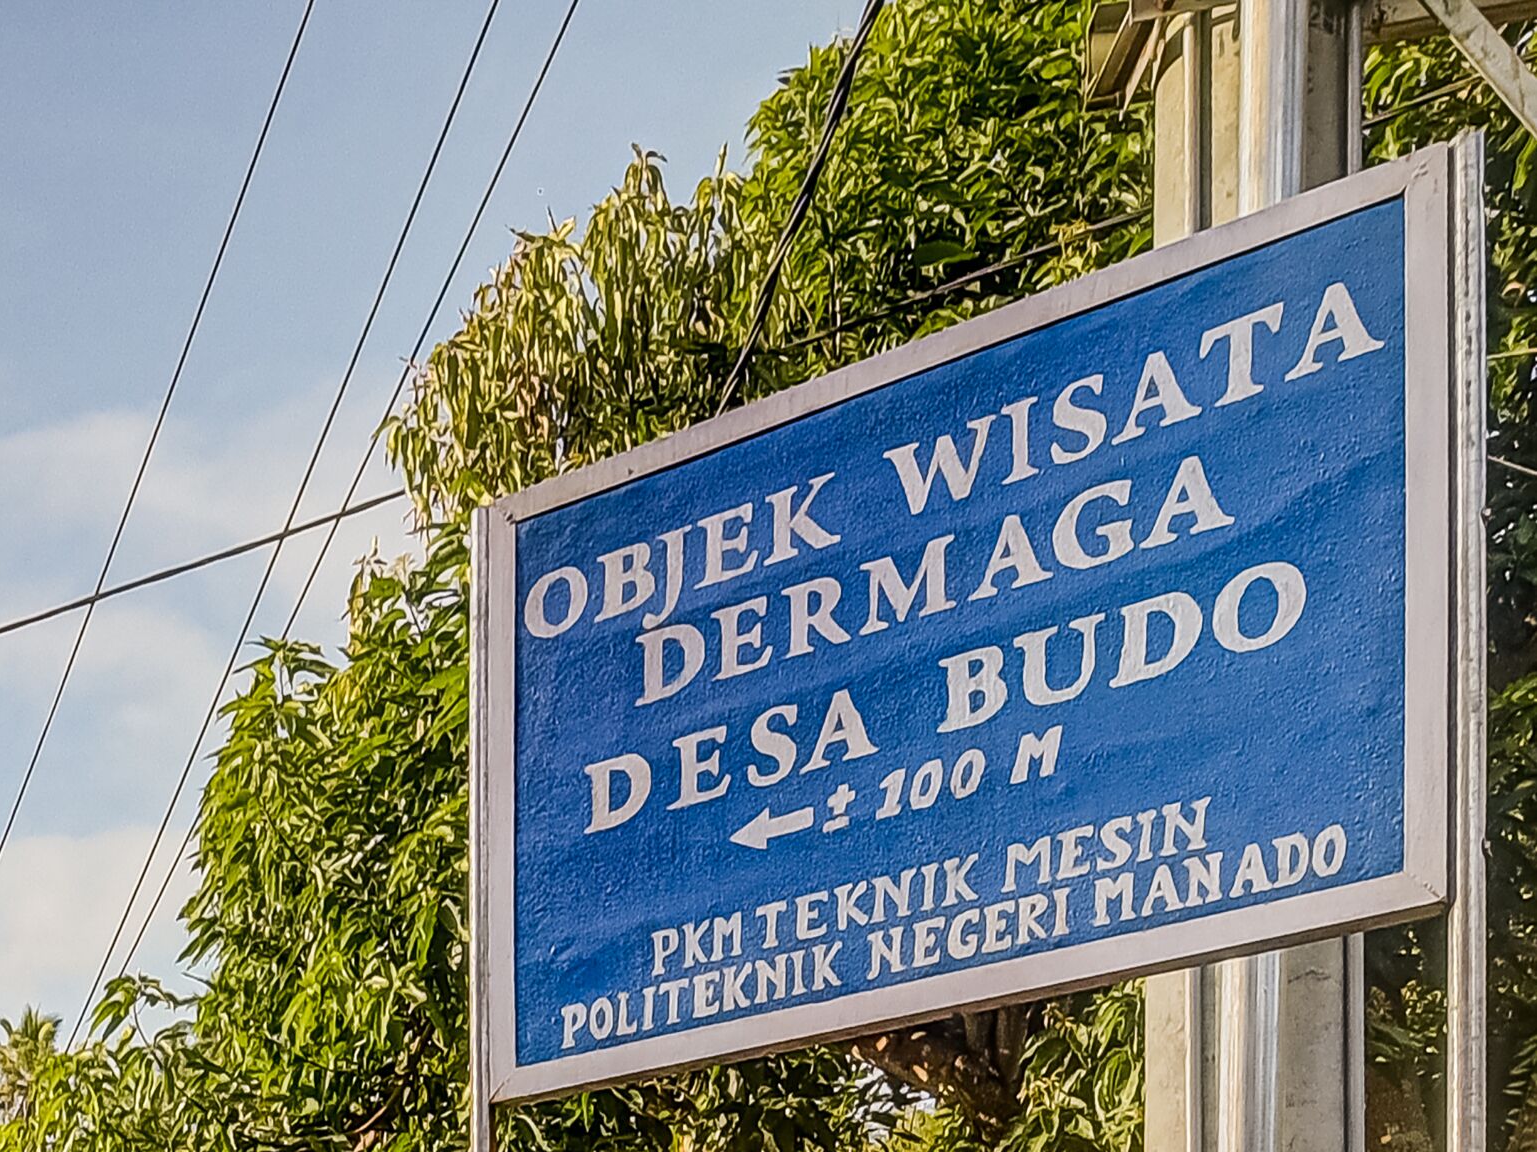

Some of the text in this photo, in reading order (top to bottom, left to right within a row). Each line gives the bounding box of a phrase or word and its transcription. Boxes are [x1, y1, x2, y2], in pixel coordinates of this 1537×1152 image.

[524, 282, 1385, 640] OBJEK WISATA
[635, 455, 1235, 707] DERMAGA
[583, 561, 1307, 834] DESA BUDO
[875, 748, 986, 821] 100
[560, 815, 1347, 1049] POLITEKNIK NEGERI MANADO
[651, 796, 1212, 978] PKM TEKNIK MESIN
